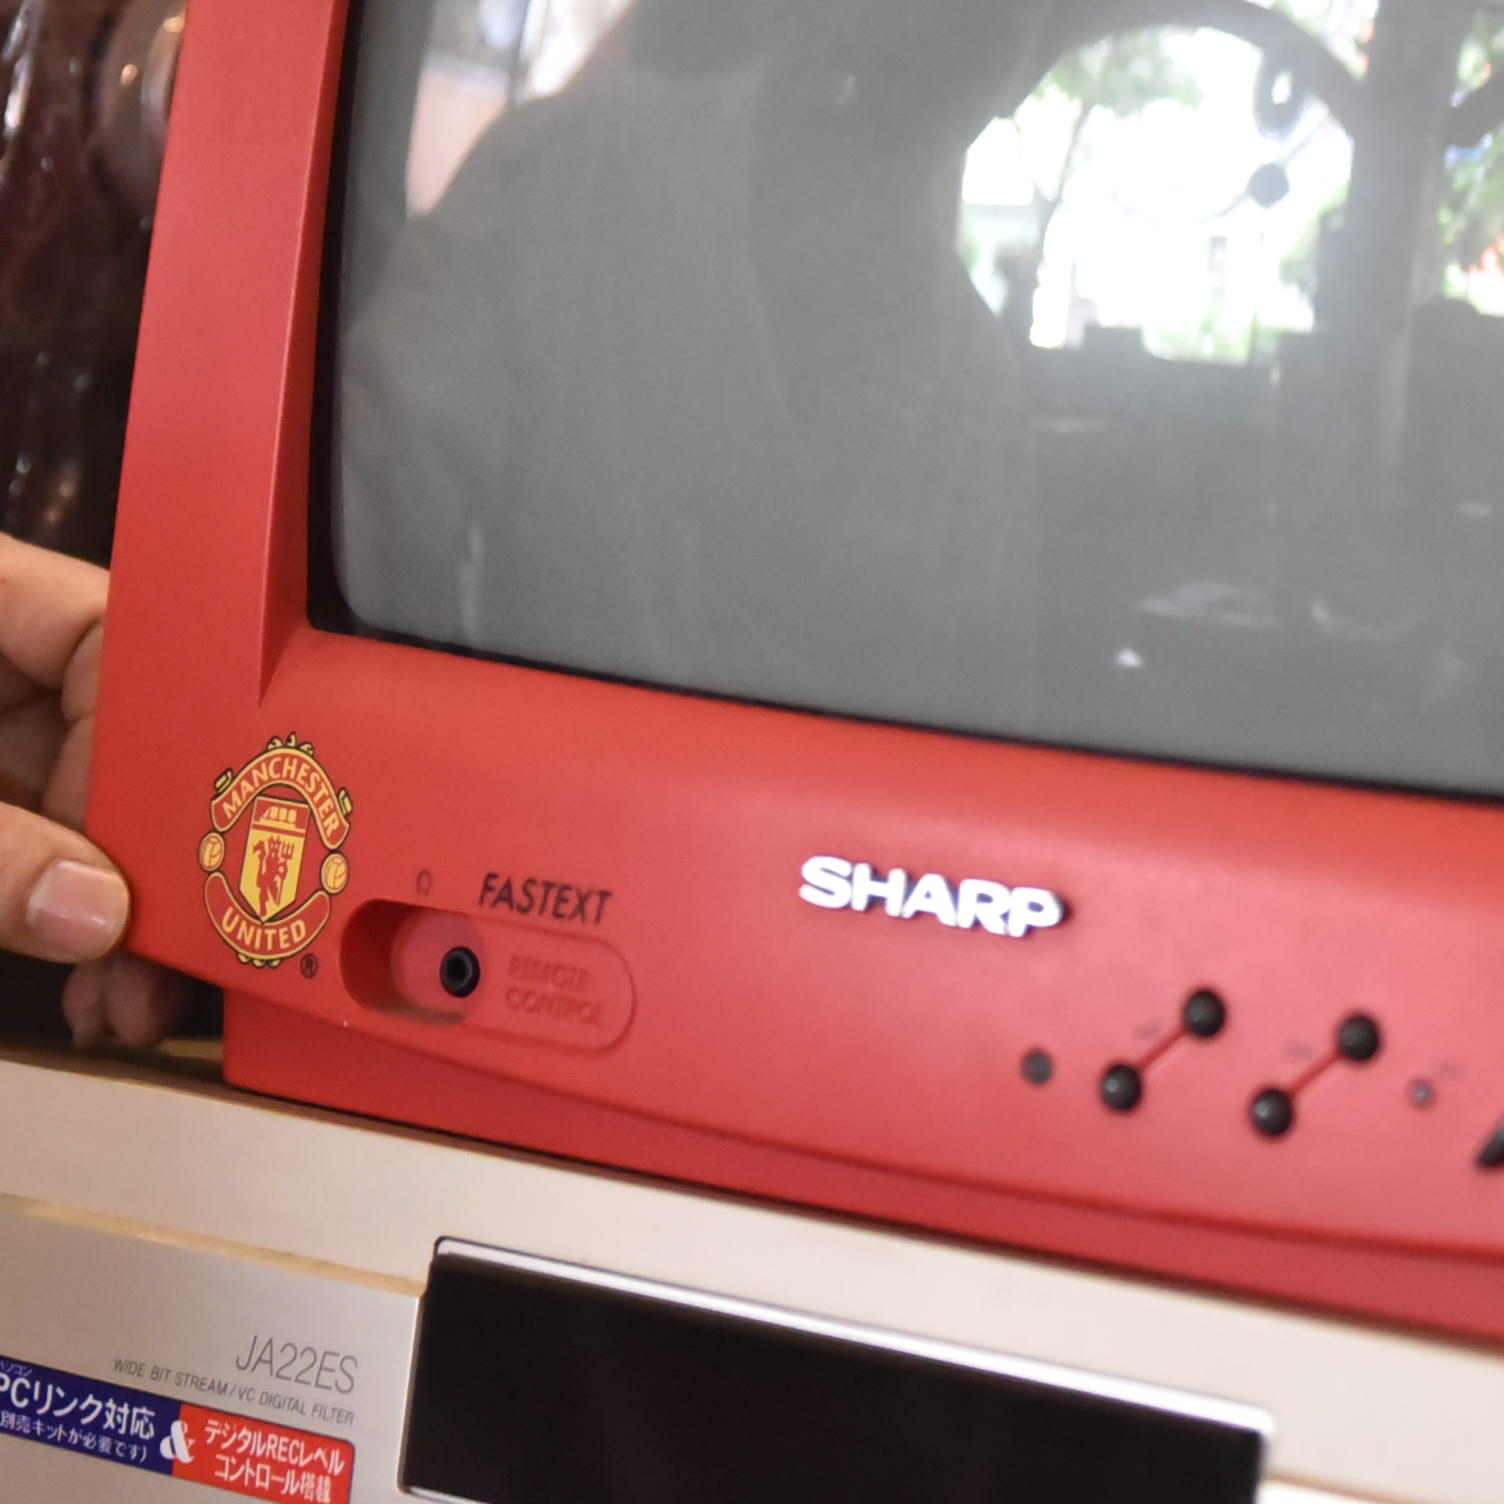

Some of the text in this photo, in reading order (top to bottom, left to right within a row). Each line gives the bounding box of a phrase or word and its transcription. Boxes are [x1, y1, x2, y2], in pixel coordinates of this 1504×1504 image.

[222, 757, 340, 837] MANCHESTER
[478, 872, 613, 925] FASTEXT
[799, 856, 1063, 937] SHARP
[222, 907, 306, 951] UNITED
[113, 1357, 146, 1378] WIDE
[149, 1365, 171, 1383] BIT
[259, 1390, 307, 1416] DIGITAL
[311, 1403, 355, 1426] FILTER
[235, 1334, 358, 1394] JA22ES
[160, 1420, 196, 1464] &
[204, 1419, 345, 1476] デジタルRECレベル
